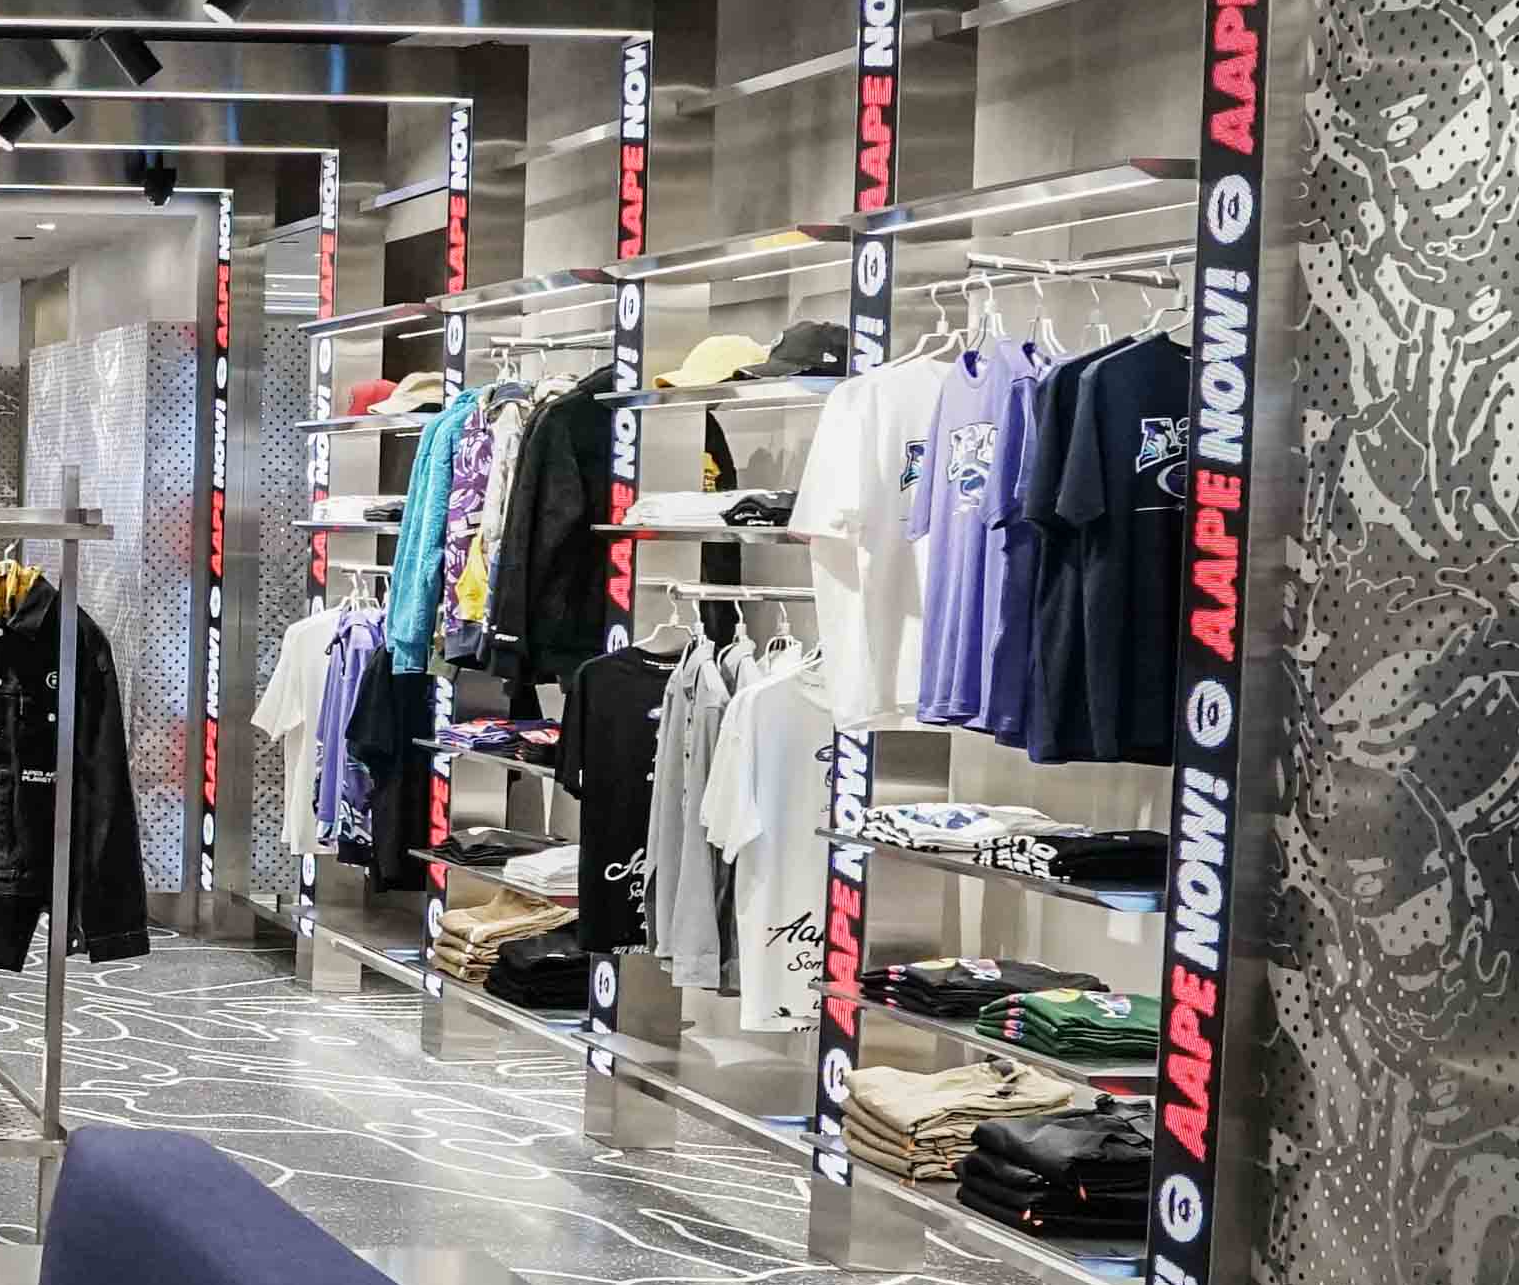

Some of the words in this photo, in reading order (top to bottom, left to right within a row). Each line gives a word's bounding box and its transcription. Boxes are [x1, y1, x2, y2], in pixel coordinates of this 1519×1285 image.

[1197, 267, 1250, 465] NOW!
[213, 398, 226, 488] NOW!
[211, 491, 224, 577] AAPE
[1190, 470, 1241, 663] AAPE
[207, 627, 220, 718] NOW!
[204, 719, 217, 806] AAPE
[1174, 766, 1228, 972] NOW!
[1164, 964, 1217, 1163] AAPE
